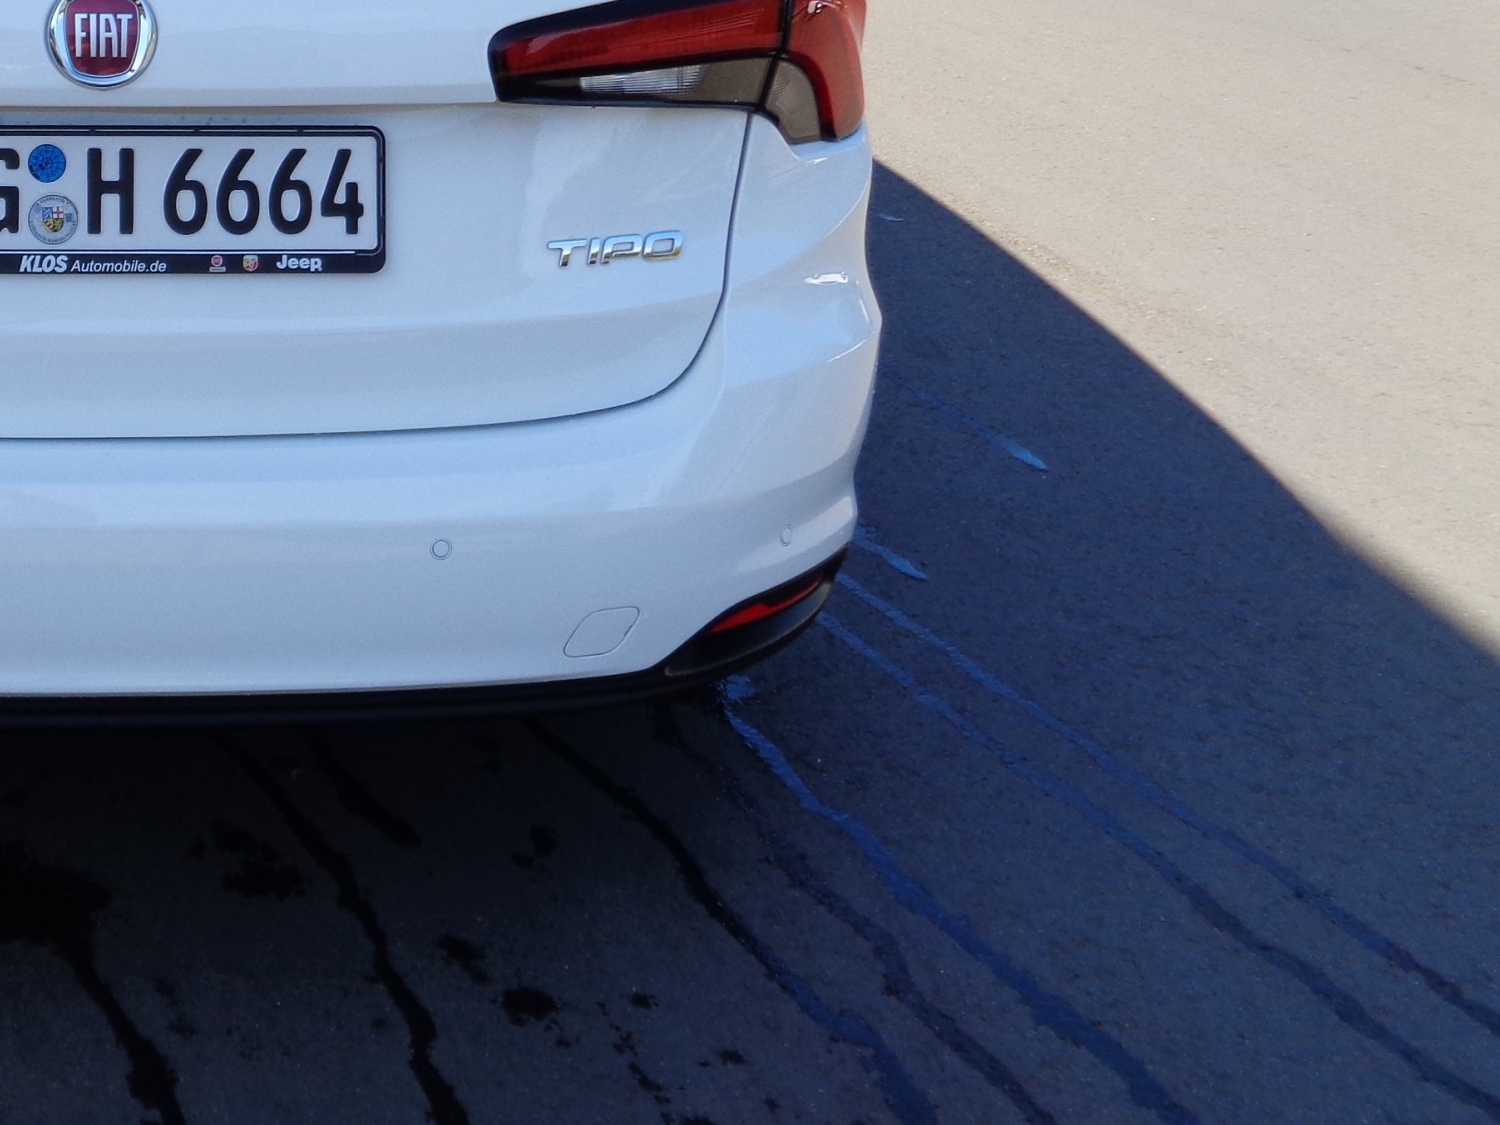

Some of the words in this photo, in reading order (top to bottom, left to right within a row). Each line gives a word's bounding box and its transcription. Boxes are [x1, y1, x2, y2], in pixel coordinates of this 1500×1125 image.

[74, 13, 133, 58] FIAT
[86, 147, 135, 235] H
[162, 147, 365, 236] 6664
[19, 255, 69, 273] KLOS
[71, 259, 167, 273] Automobile.de
[276, 254, 323, 272] Jeep
[547, 230, 685, 268] TIPO
